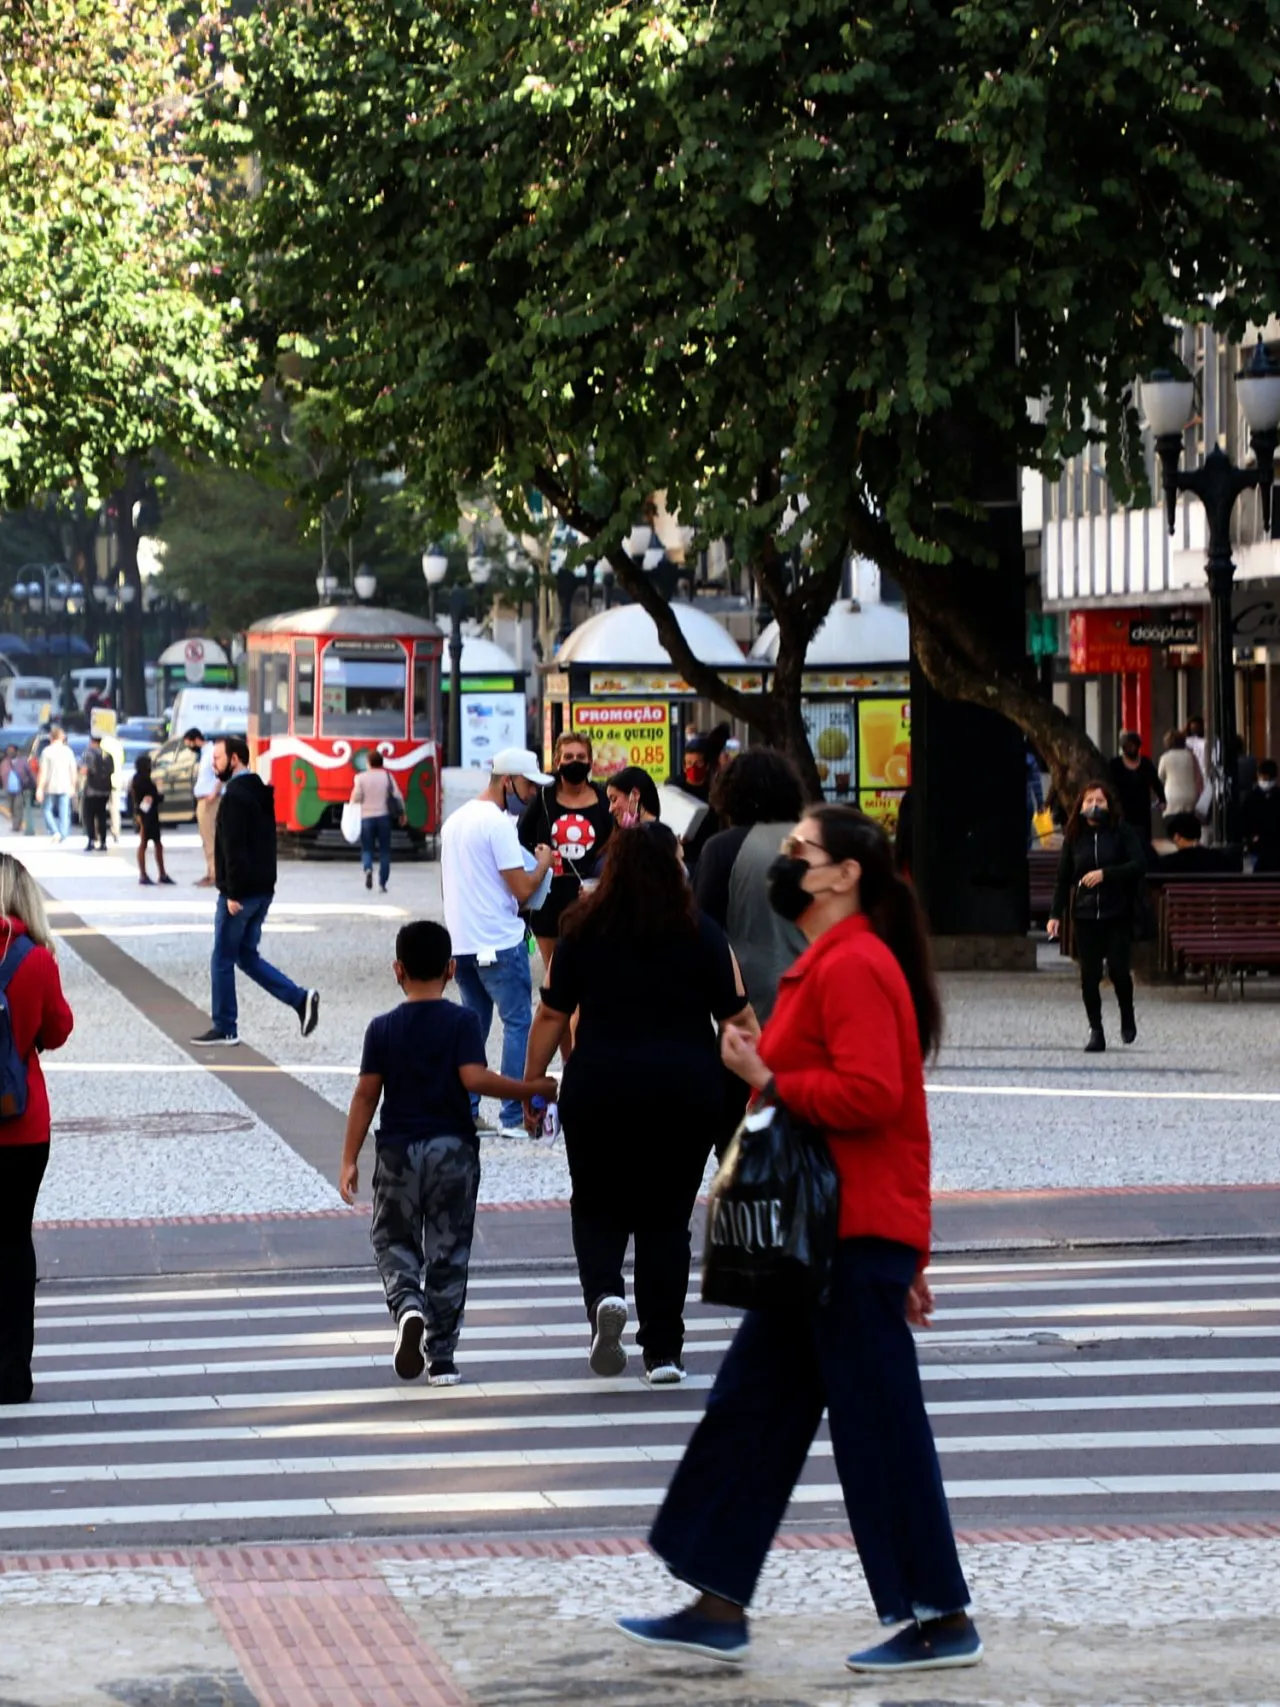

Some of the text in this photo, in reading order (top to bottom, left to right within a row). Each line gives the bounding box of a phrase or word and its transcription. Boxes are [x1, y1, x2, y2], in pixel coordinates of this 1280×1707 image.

[580, 705, 662, 723] PROMOÇÃO
[624, 728, 664, 741] QUEIJO
[631, 745, 665, 766] 0,85
[710, 1197, 784, 1254] UNIQUE
